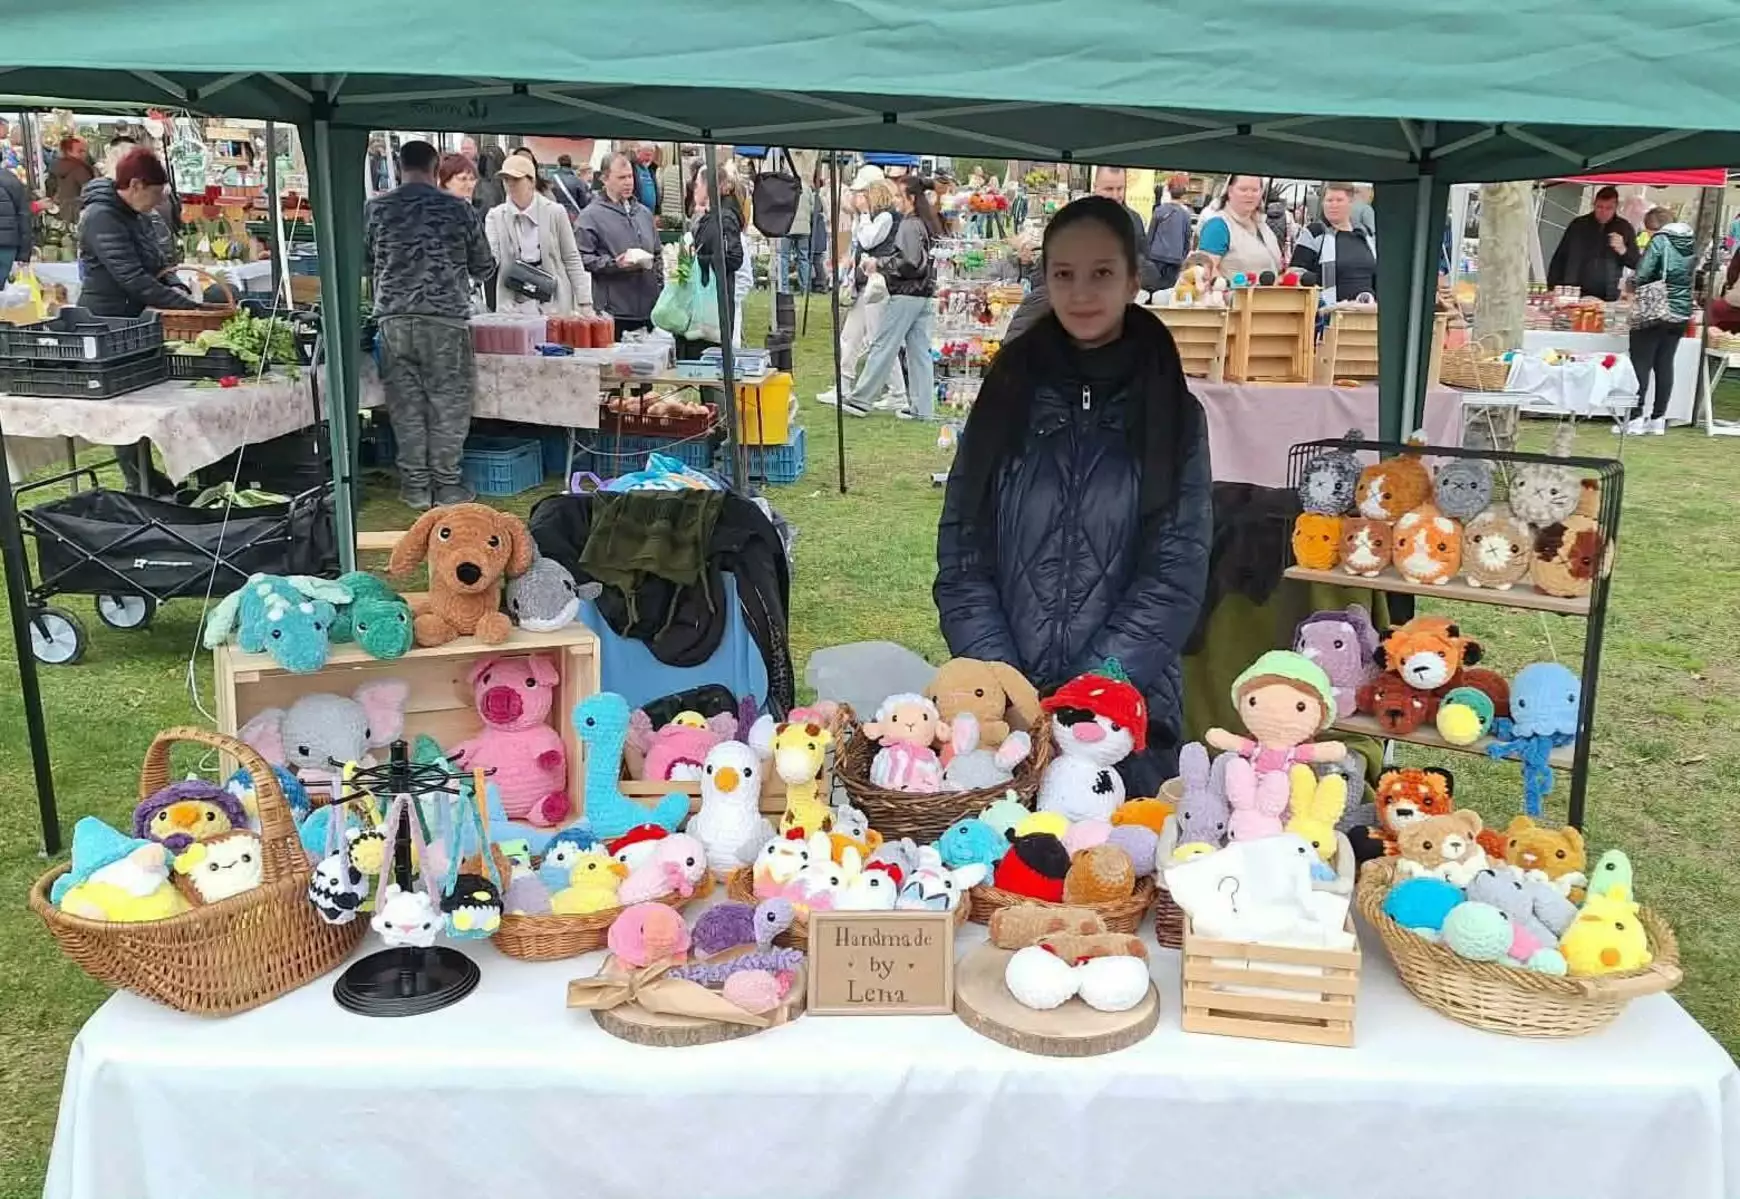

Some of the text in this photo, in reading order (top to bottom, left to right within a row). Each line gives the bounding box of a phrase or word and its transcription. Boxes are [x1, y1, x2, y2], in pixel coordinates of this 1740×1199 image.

[836, 927, 933, 946] Handmade
[870, 956, 895, 979] by
[848, 980, 907, 1003] Lena
